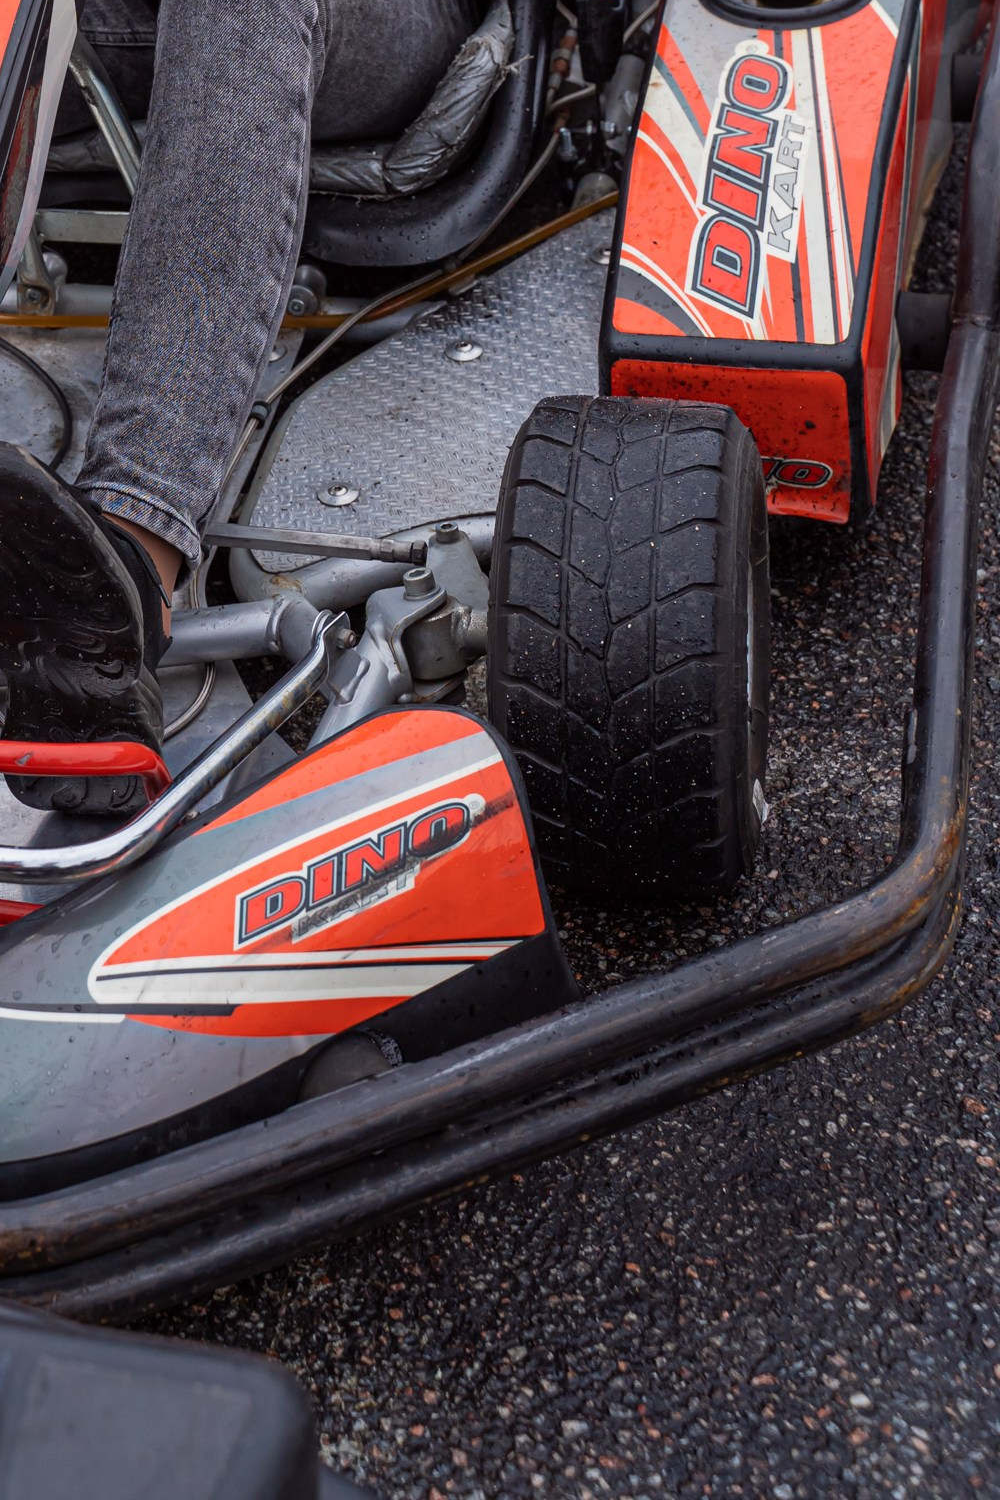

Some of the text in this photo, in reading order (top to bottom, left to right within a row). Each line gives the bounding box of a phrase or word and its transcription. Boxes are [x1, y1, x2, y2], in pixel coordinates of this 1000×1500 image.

[690, 54, 790, 320] DINO
[766, 114, 806, 253] KART
[237, 801, 471, 945] DINO
